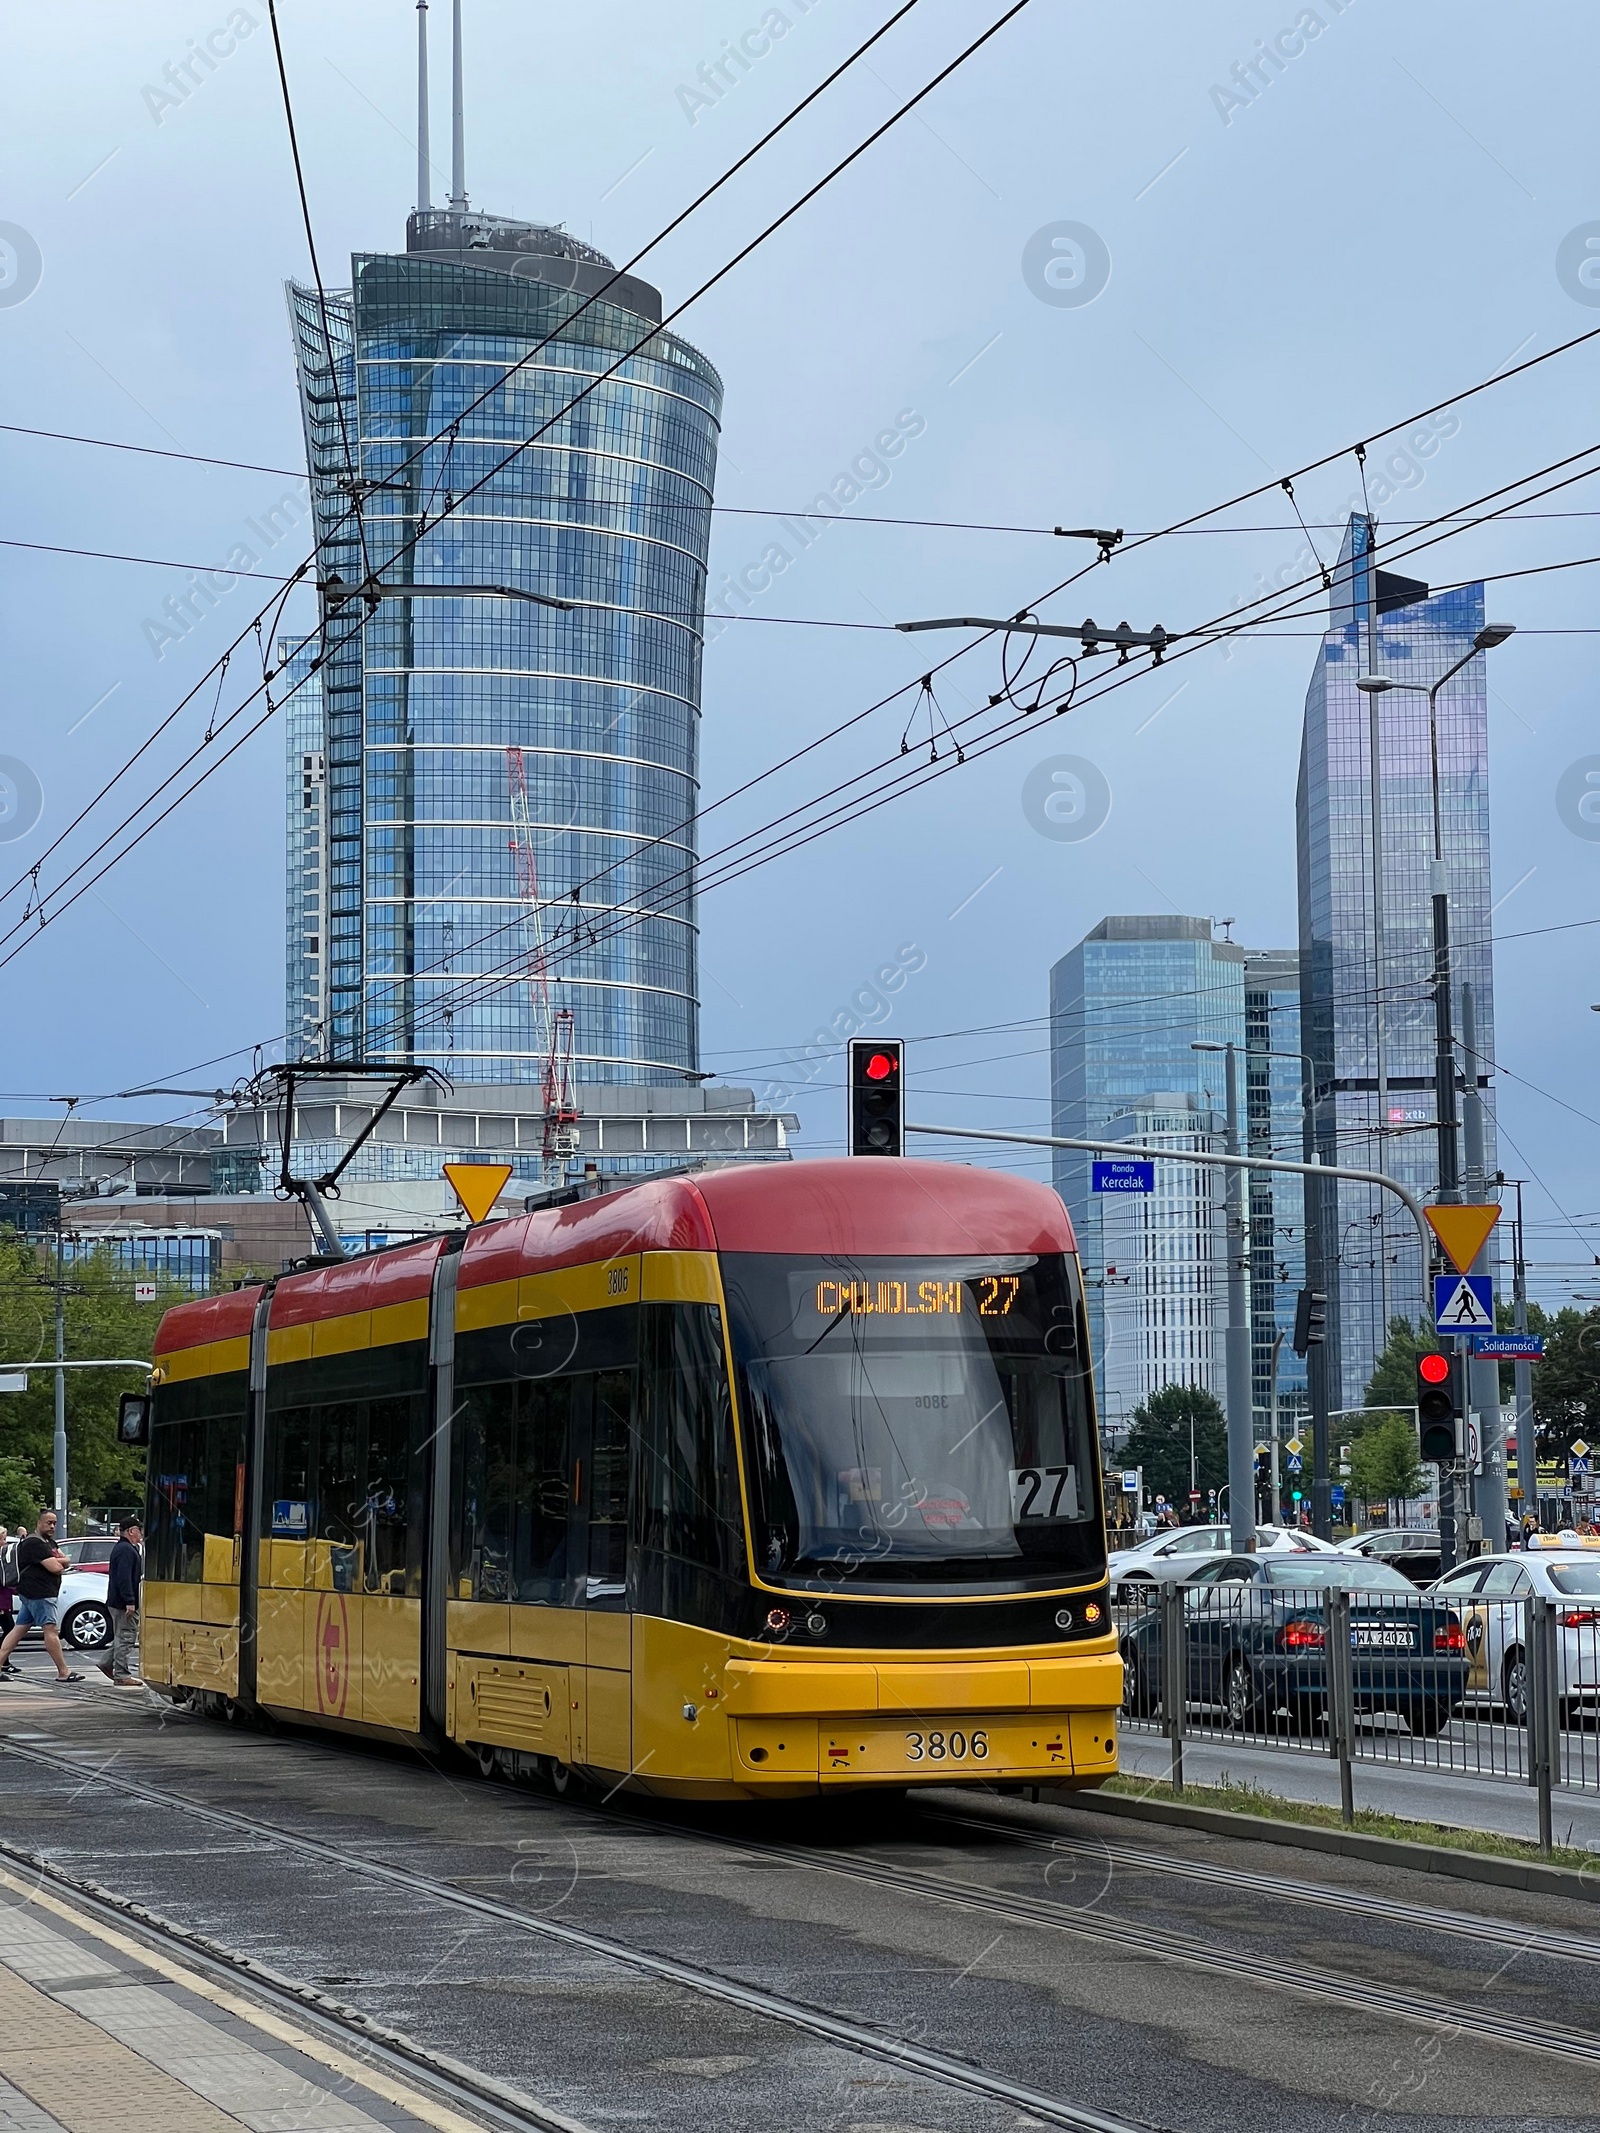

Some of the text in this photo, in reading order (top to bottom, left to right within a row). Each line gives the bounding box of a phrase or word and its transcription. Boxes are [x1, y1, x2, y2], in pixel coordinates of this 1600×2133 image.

[1101, 1176, 1144, 1188] Kercelak
[1112, 1164, 1134, 1173] Rondo
[607, 1267, 629, 1296] 3806
[979, 1276, 1019, 1315] 27
[1017, 1467, 1069, 1519] 27
[905, 1731, 989, 1762] 3806
